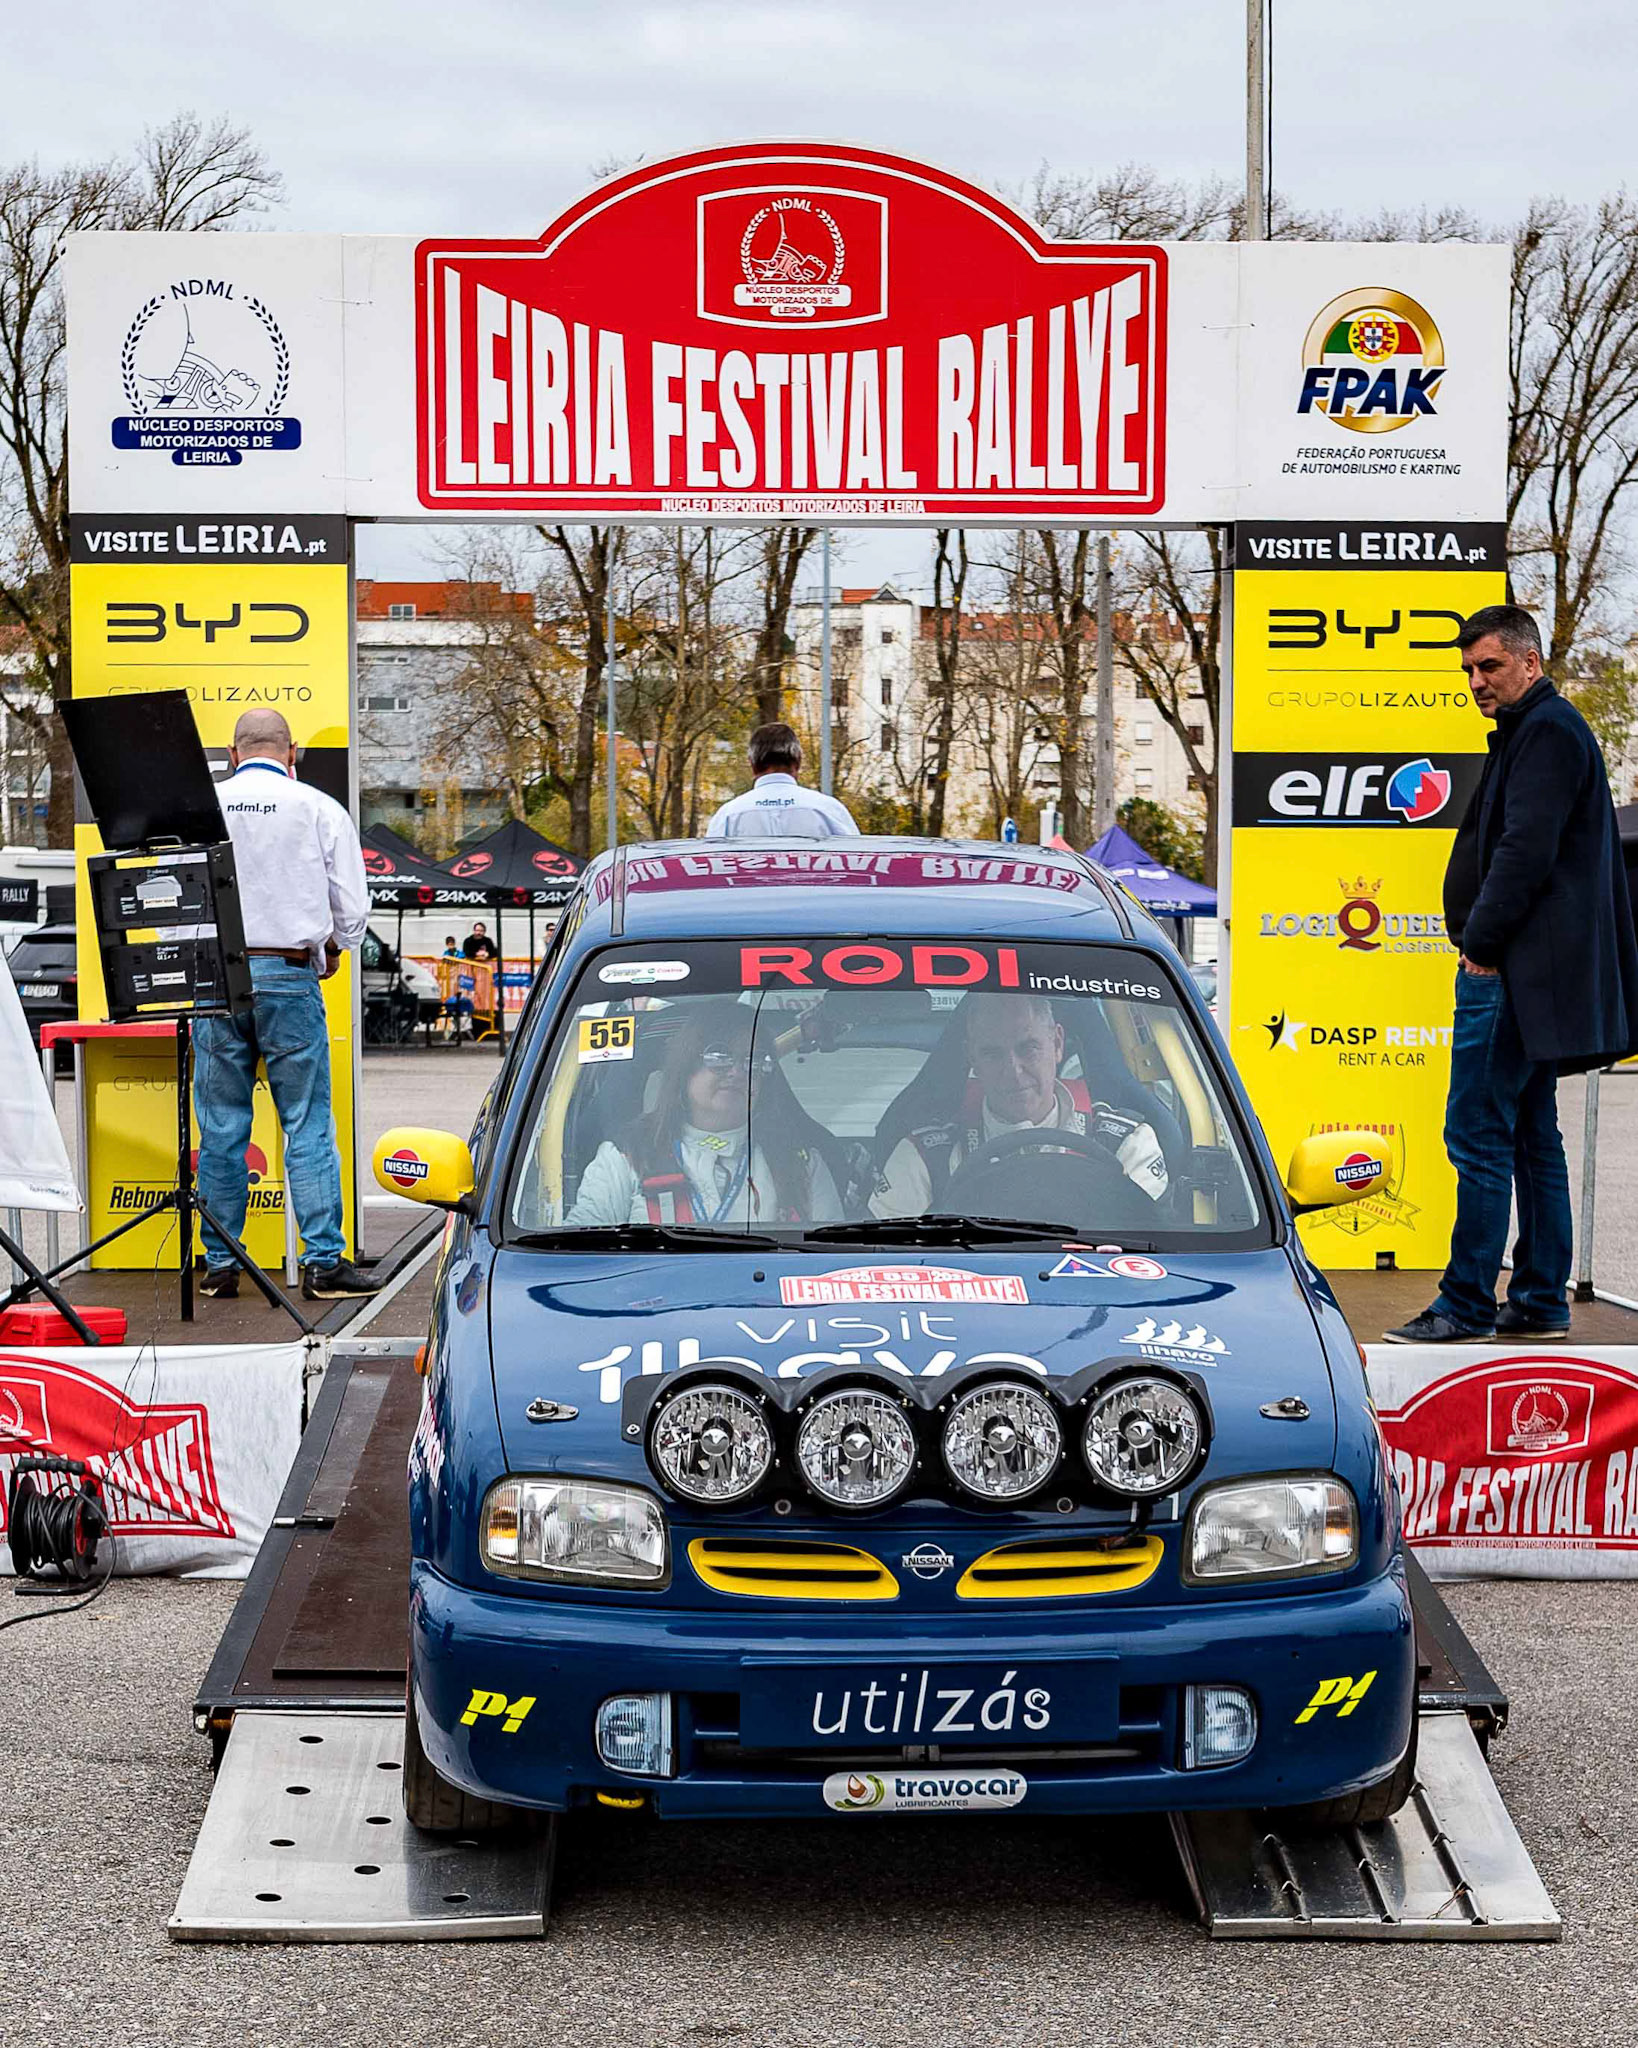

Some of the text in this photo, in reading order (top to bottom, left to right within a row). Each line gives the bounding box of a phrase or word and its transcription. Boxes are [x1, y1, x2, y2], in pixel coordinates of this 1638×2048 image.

[771, 198, 812, 212] NDML
[170, 279, 235, 300] NDML
[753, 296, 817, 304] MOTORIZADOS
[778, 306, 808, 314] LEIRIA
[444, 265, 1143, 492] LEIRIA FESTIVAL RALLYE
[1297, 366, 1448, 416] FPAK
[129, 415, 285, 432] NÚCLEO DESPORTOS
[140, 435, 273, 448] MOTORIZADOS DE
[183, 450, 231, 464] LEIRIA
[1297, 446, 1446, 461] FEDERAÇÃO PORTUGUESA
[1282, 462, 1461, 475] DE AUTOMOBILISMO E KARTING
[713, 499, 781, 513] DESPORTOS
[783, 499, 866, 513] MOTORIZADOS
[868, 500, 885, 513] DE
[887, 500, 926, 514] LEIRIA
[84, 531, 169, 553] VISITE
[1248, 538, 1332, 558] VISITE
[106, 602, 310, 643] BYD
[1268, 609, 1464, 649] BYD
[1268, 765, 1385, 817] elf
[227, 802, 276, 815] ndml.pt
[755, 797, 795, 807] ndml.pt
[2, 888, 30, 902] RALLY
[435, 890, 487, 904] 24MX
[533, 891, 573, 904] 24M
[1260, 899, 1449, 951] LOGIQUEE
[740, 945, 1020, 986] RODI
[1028, 972, 1162, 1000] industries
[590, 1019, 631, 1050] 55
[1311, 1026, 1453, 1047] DASP RENT
[1339, 1053, 1425, 1066] RENT A CAR
[385, 1161, 426, 1176] NISSAN
[1337, 1163, 1381, 1181] NISSAN
[791, 1279, 1016, 1301] LEIRIA FESTIVAL RALLYE
[1387, 1446, 1446, 1538] RIA
[1448, 1458, 1593, 1536] FESTIVAL
[907, 1557, 949, 1566] NISSAN
[812, 1670, 1051, 1735] utilzás
[895, 1777, 1021, 1798] travocar
[895, 1799, 969, 1808] LUBRIFICANTES
